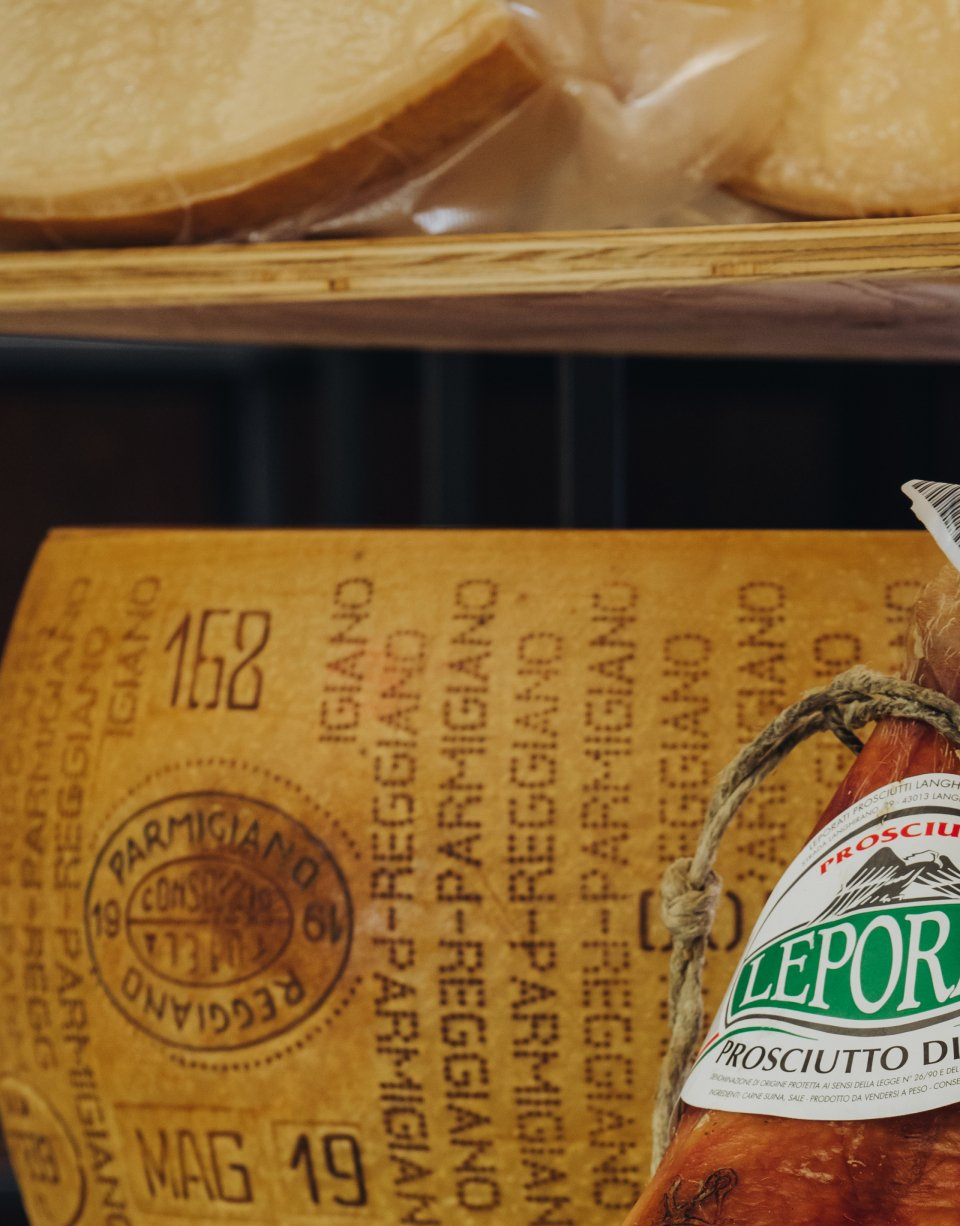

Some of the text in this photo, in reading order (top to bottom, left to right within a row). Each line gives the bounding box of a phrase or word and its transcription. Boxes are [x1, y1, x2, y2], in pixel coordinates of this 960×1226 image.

[103, 575, 161, 738] IGIANO
[164, 608, 272, 711] 168
[318, 577, 375, 743] IGIANO
[54, 625, 113, 890] REGGIANO
[370, 628, 428, 900] REGGIANO
[437, 578, 499, 902] PARMIGIANO
[507, 631, 565, 903] REGGIANO
[580, 579, 640, 900] PARMIGIANO
[656, 632, 714, 867] EGGIANO
[853, 781, 912, 816] PROSCIUTTI
[902, 792, 929, 804] 43013
[108, 810, 320, 891] PARMIGIANO
[92, 898, 122, 940] 19
[122, 965, 306, 1035] REGGIANO
[437, 937, 501, 1213] REGGIANO
[715, 1039, 909, 1074] PROSCIUTTO
[922, 1036, 960, 1066] DI
[787, 1080, 820, 1090] PROTETTA
[822, 1081, 831, 1089] AI
[832, 1080, 853, 1090] SENSI
[854, 1079, 875, 1089] DELLA
[876, 1076, 901, 1088] LEGGE
[913, 1070, 938, 1082] 26/90
[946, 1065, 960, 1075] DEL
[787, 1093, 805, 1103] SALE
[810, 1093, 850, 1103] PRODOTTO
[852, 1093, 862, 1102] DA
[864, 1090, 900, 1101] VENDERSI
[908, 1085, 928, 1096] PESO
[135, 1128, 254, 1204] MAG
[290, 1133, 368, 1207] 19
